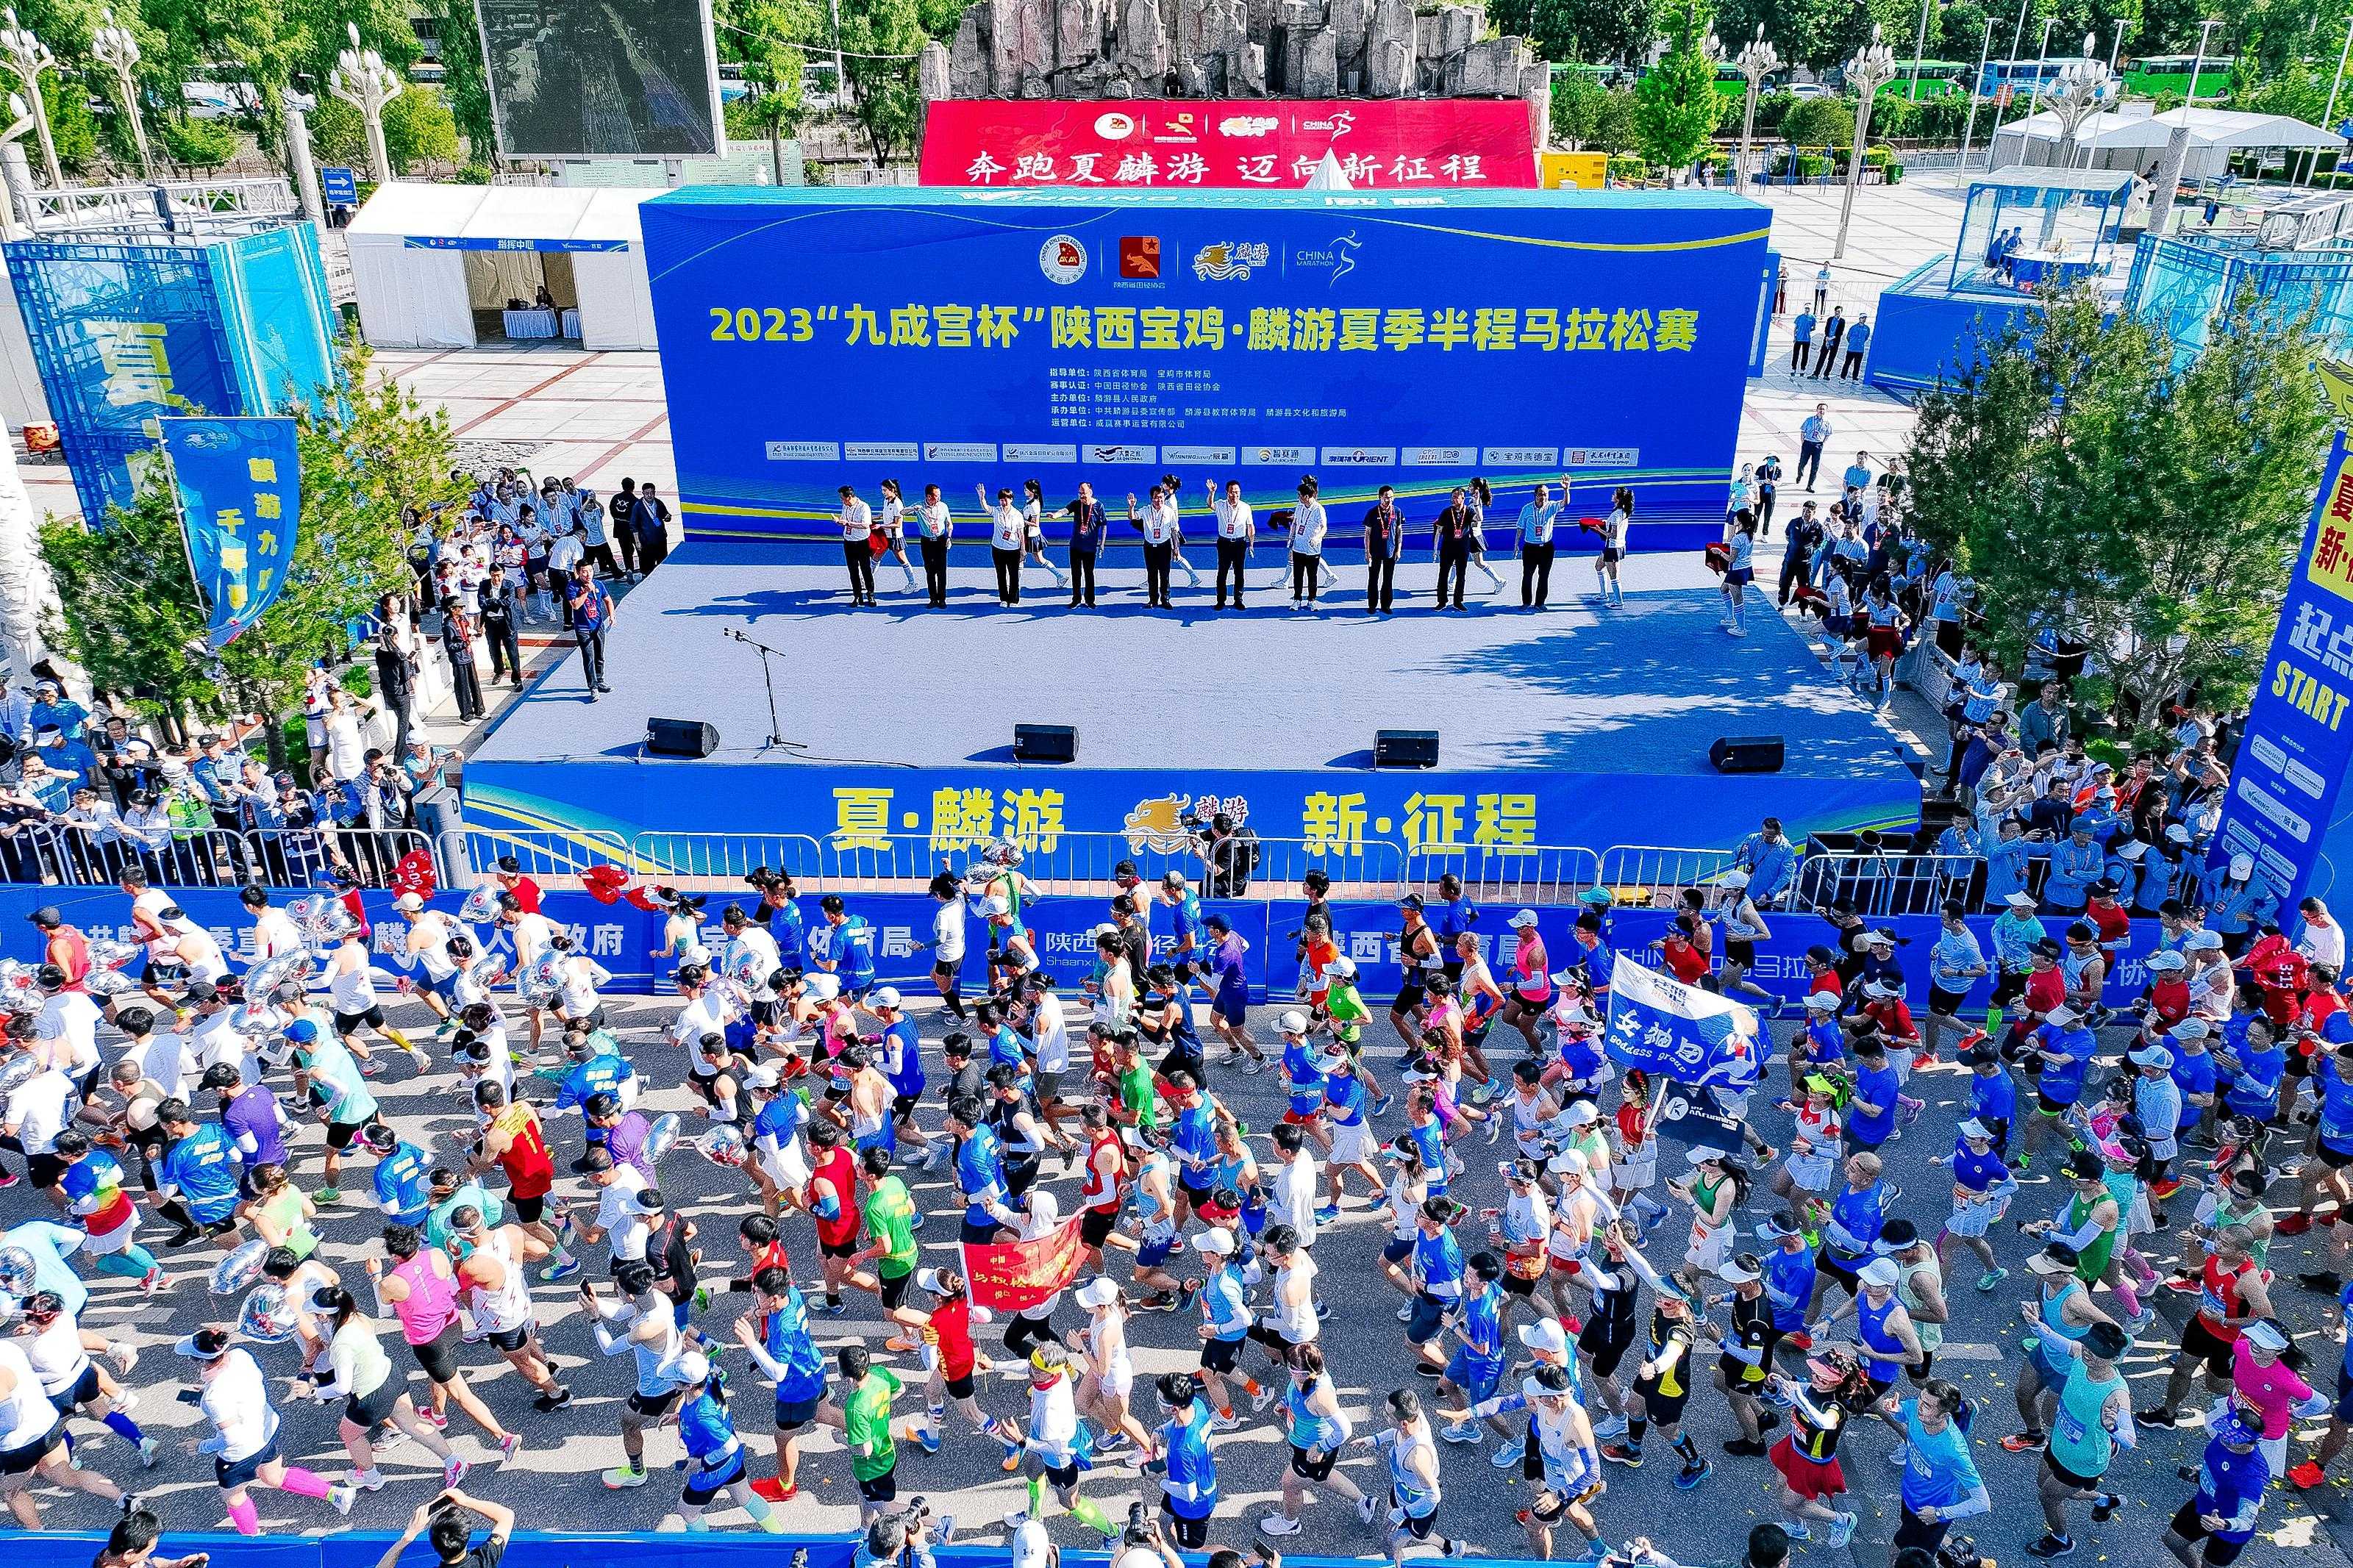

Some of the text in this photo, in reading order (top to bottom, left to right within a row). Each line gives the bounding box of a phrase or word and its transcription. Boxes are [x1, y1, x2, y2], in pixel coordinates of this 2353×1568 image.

[965, 151, 1488, 185] 奔跑夏麟游 迈向新征程
[497, 240, 535, 248] 指挥中心
[1296, 251, 1334, 260] CHINA
[1157, 370, 1211, 378] 宝鸡市体育局
[1157, 382, 1220, 391] 陕西省田径协会
[1503, 452, 1553, 462] 宝鸡燕德宝
[2288, 601, 2353, 681] 起点
[2272, 660, 2349, 731] START
[832, 786, 1537, 856] 夏·麟游 新·征程
[1610, 1034, 1686, 1073] goddess group
